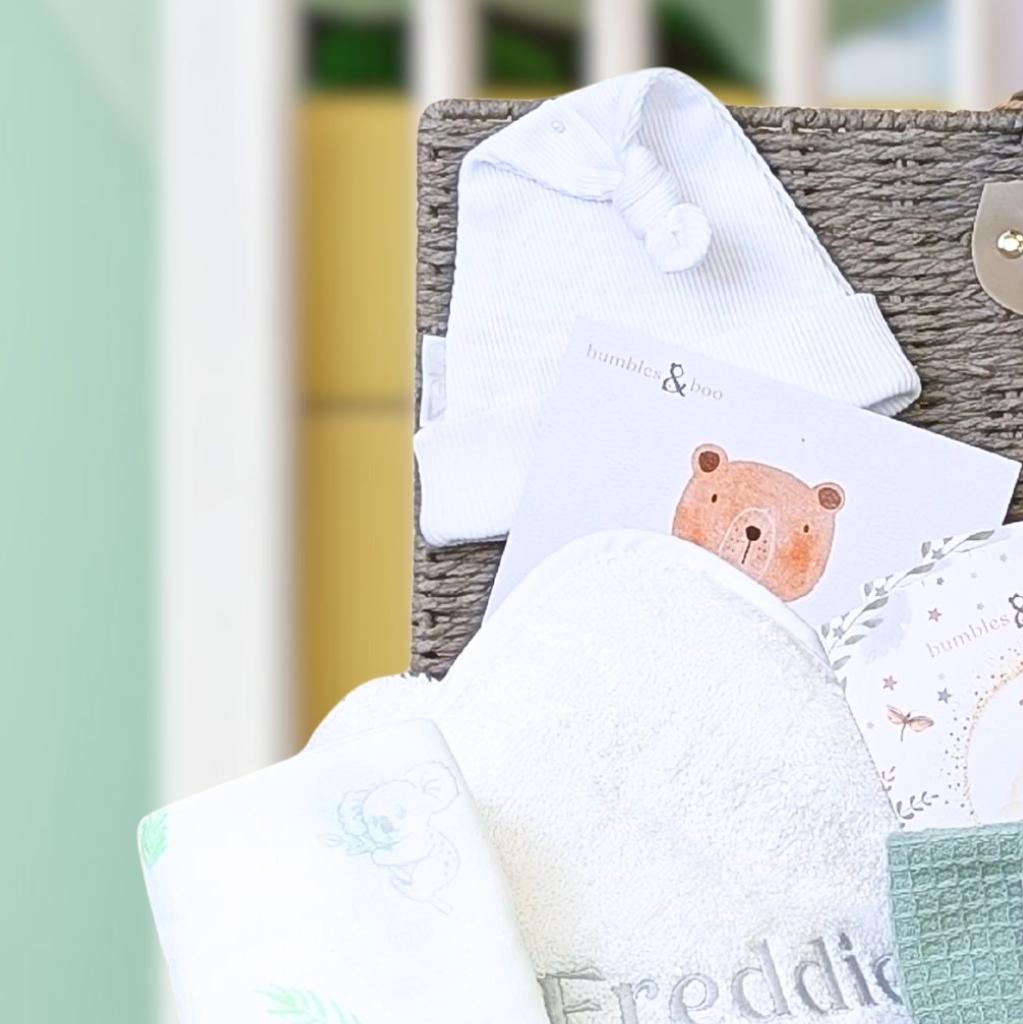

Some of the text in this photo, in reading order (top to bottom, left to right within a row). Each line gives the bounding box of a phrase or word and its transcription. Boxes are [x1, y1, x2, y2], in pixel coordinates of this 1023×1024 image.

[586, 343, 724, 401] bumbles & boo
[925, 613, 1010, 658] bumbles
